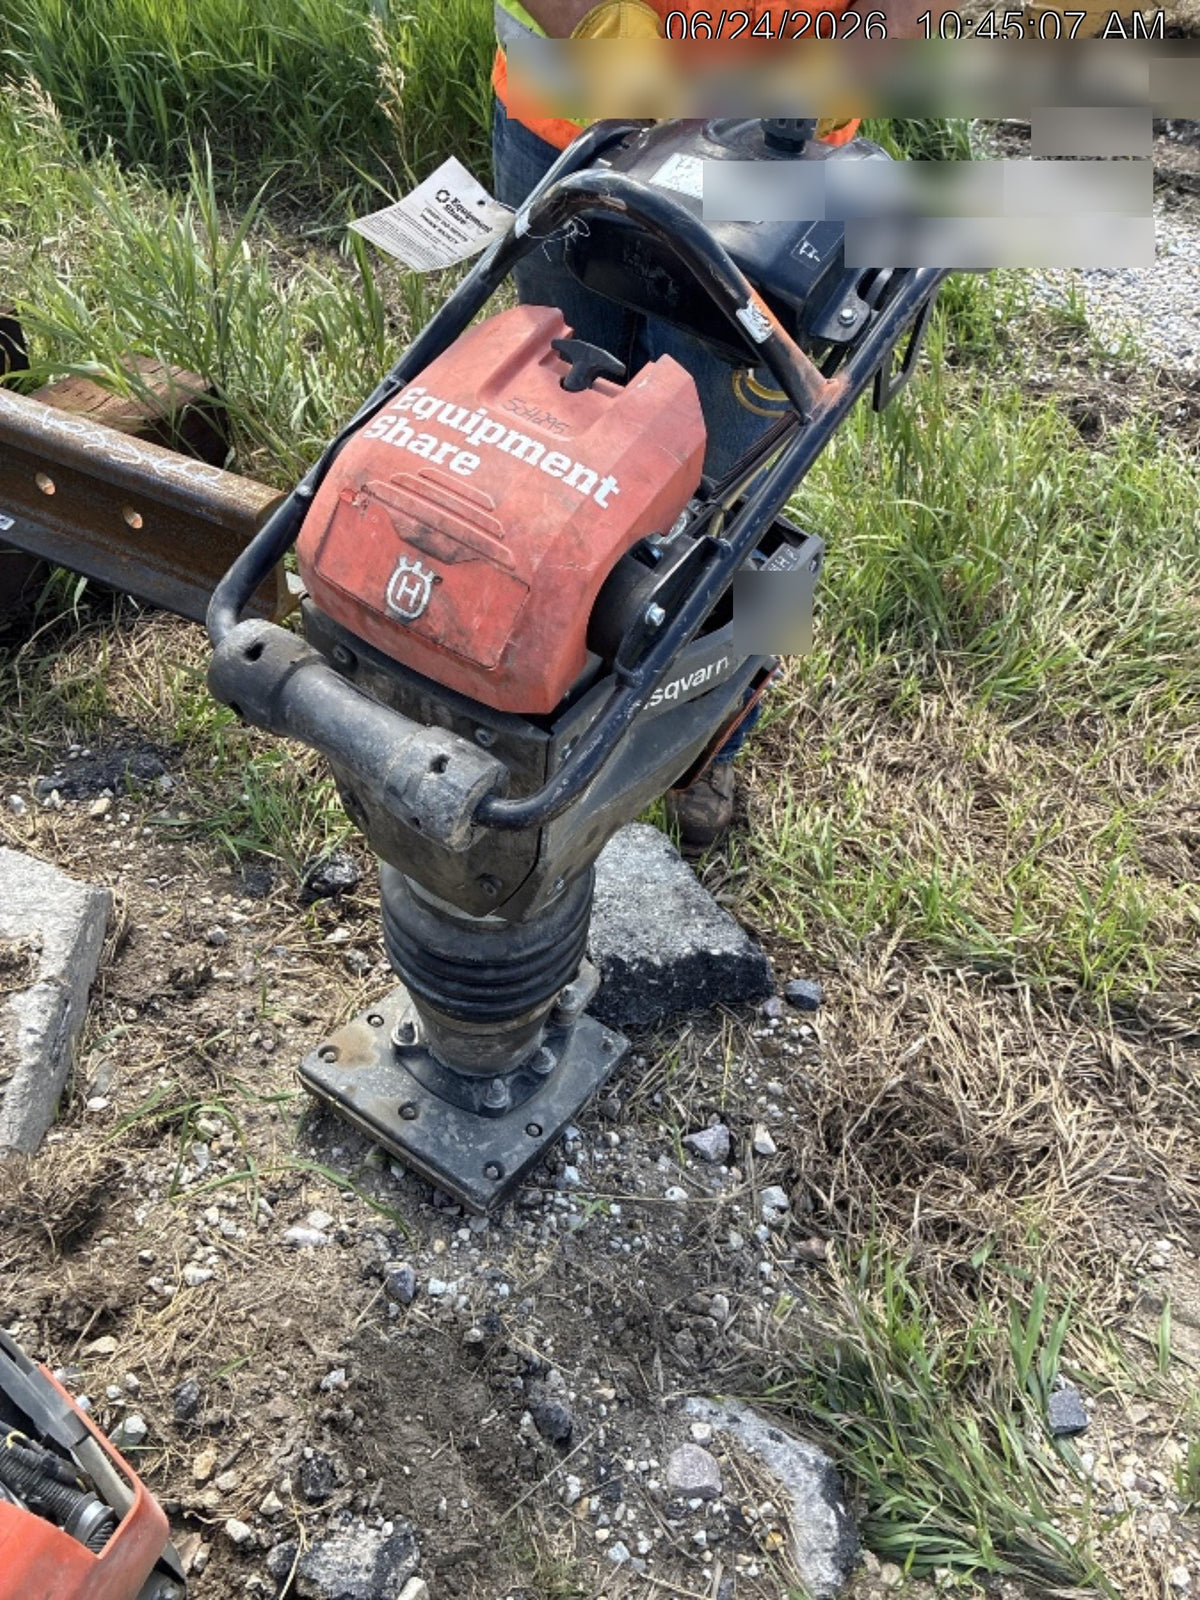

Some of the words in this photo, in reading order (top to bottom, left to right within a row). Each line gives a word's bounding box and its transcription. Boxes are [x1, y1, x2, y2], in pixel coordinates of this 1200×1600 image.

[443, 204, 466, 224] Share
[450, 197, 493, 233] Equipment
[363, 415, 481, 476] Share
[390, 387, 621, 509] Equipment
